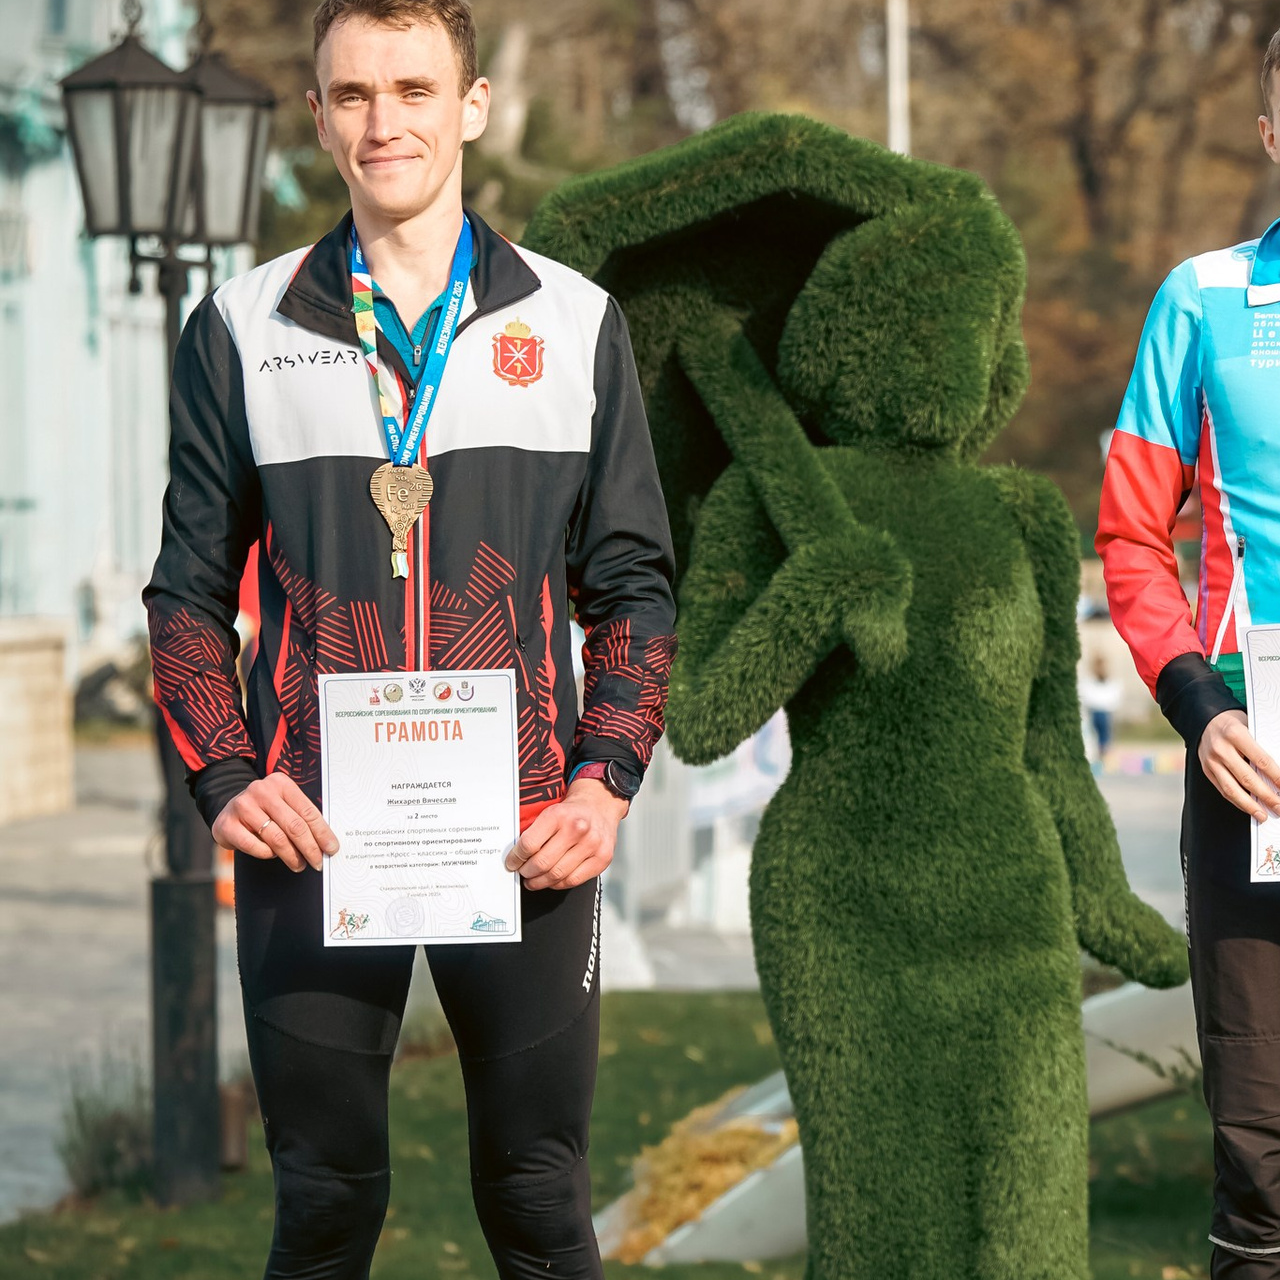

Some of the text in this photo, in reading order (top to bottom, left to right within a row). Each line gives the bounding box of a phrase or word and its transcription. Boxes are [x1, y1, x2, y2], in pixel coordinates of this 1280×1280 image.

[435, 280, 464, 357] ЖЕЛЕЗНОВОДСК 2025
[259, 350, 358, 372] ARSWEAR
[405, 384, 435, 450] ОРИЕНТИРОВАНИЮ
[387, 424, 397, 434] ПО
[386, 483, 409, 502] Fe
[335, 710, 374, 718] ВСЕРОССИЙСКИЕ
[374, 709, 412, 717] СОРЕВНОВАНИЯ
[419, 708, 453, 716] СПОРТИВНОМУ
[454, 706, 498, 714] ОРИЕНТИРОВАНИЮ
[374, 720, 464, 743] ГРАМОТА
[391, 781, 452, 790] НАГРАЖДАЕТСЯ
[387, 798, 421, 806] Жихарев
[355, 829, 405, 837] Всероссийских
[448, 825, 500, 833] соревнованиях
[421, 838, 482, 846] ориентированию
